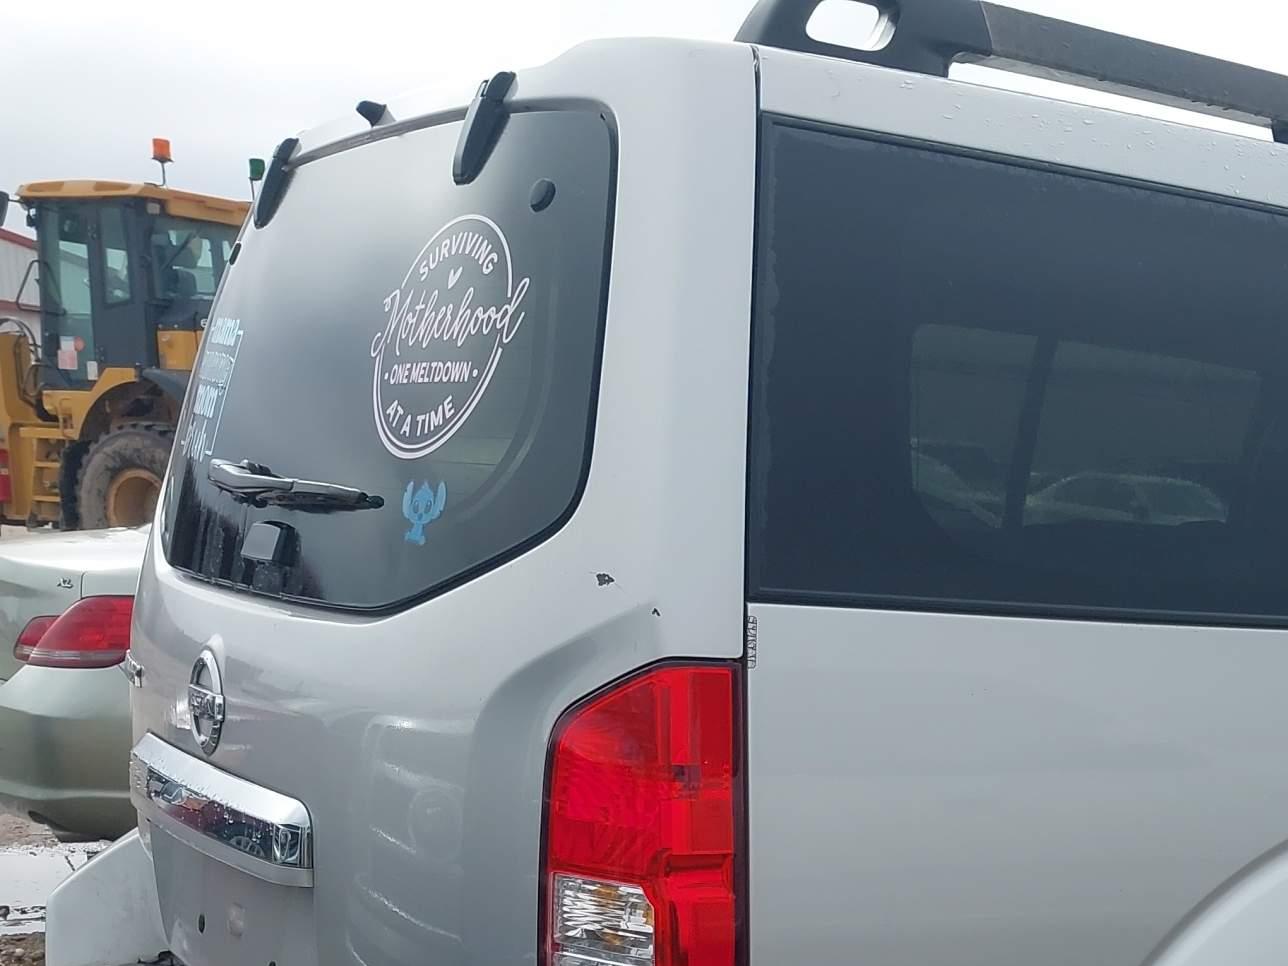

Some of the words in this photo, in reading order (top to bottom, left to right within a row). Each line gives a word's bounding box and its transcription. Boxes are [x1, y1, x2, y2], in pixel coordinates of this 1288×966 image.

[420, 231, 498, 281] SURVIVING
[370, 277, 530, 357] Motherhood
[389, 362, 411, 385] ONE
[409, 361, 472, 383] MELTDOWN
[386, 399, 404, 427] AT
[400, 419, 410, 437] A
[416, 395, 455, 436] TIME
